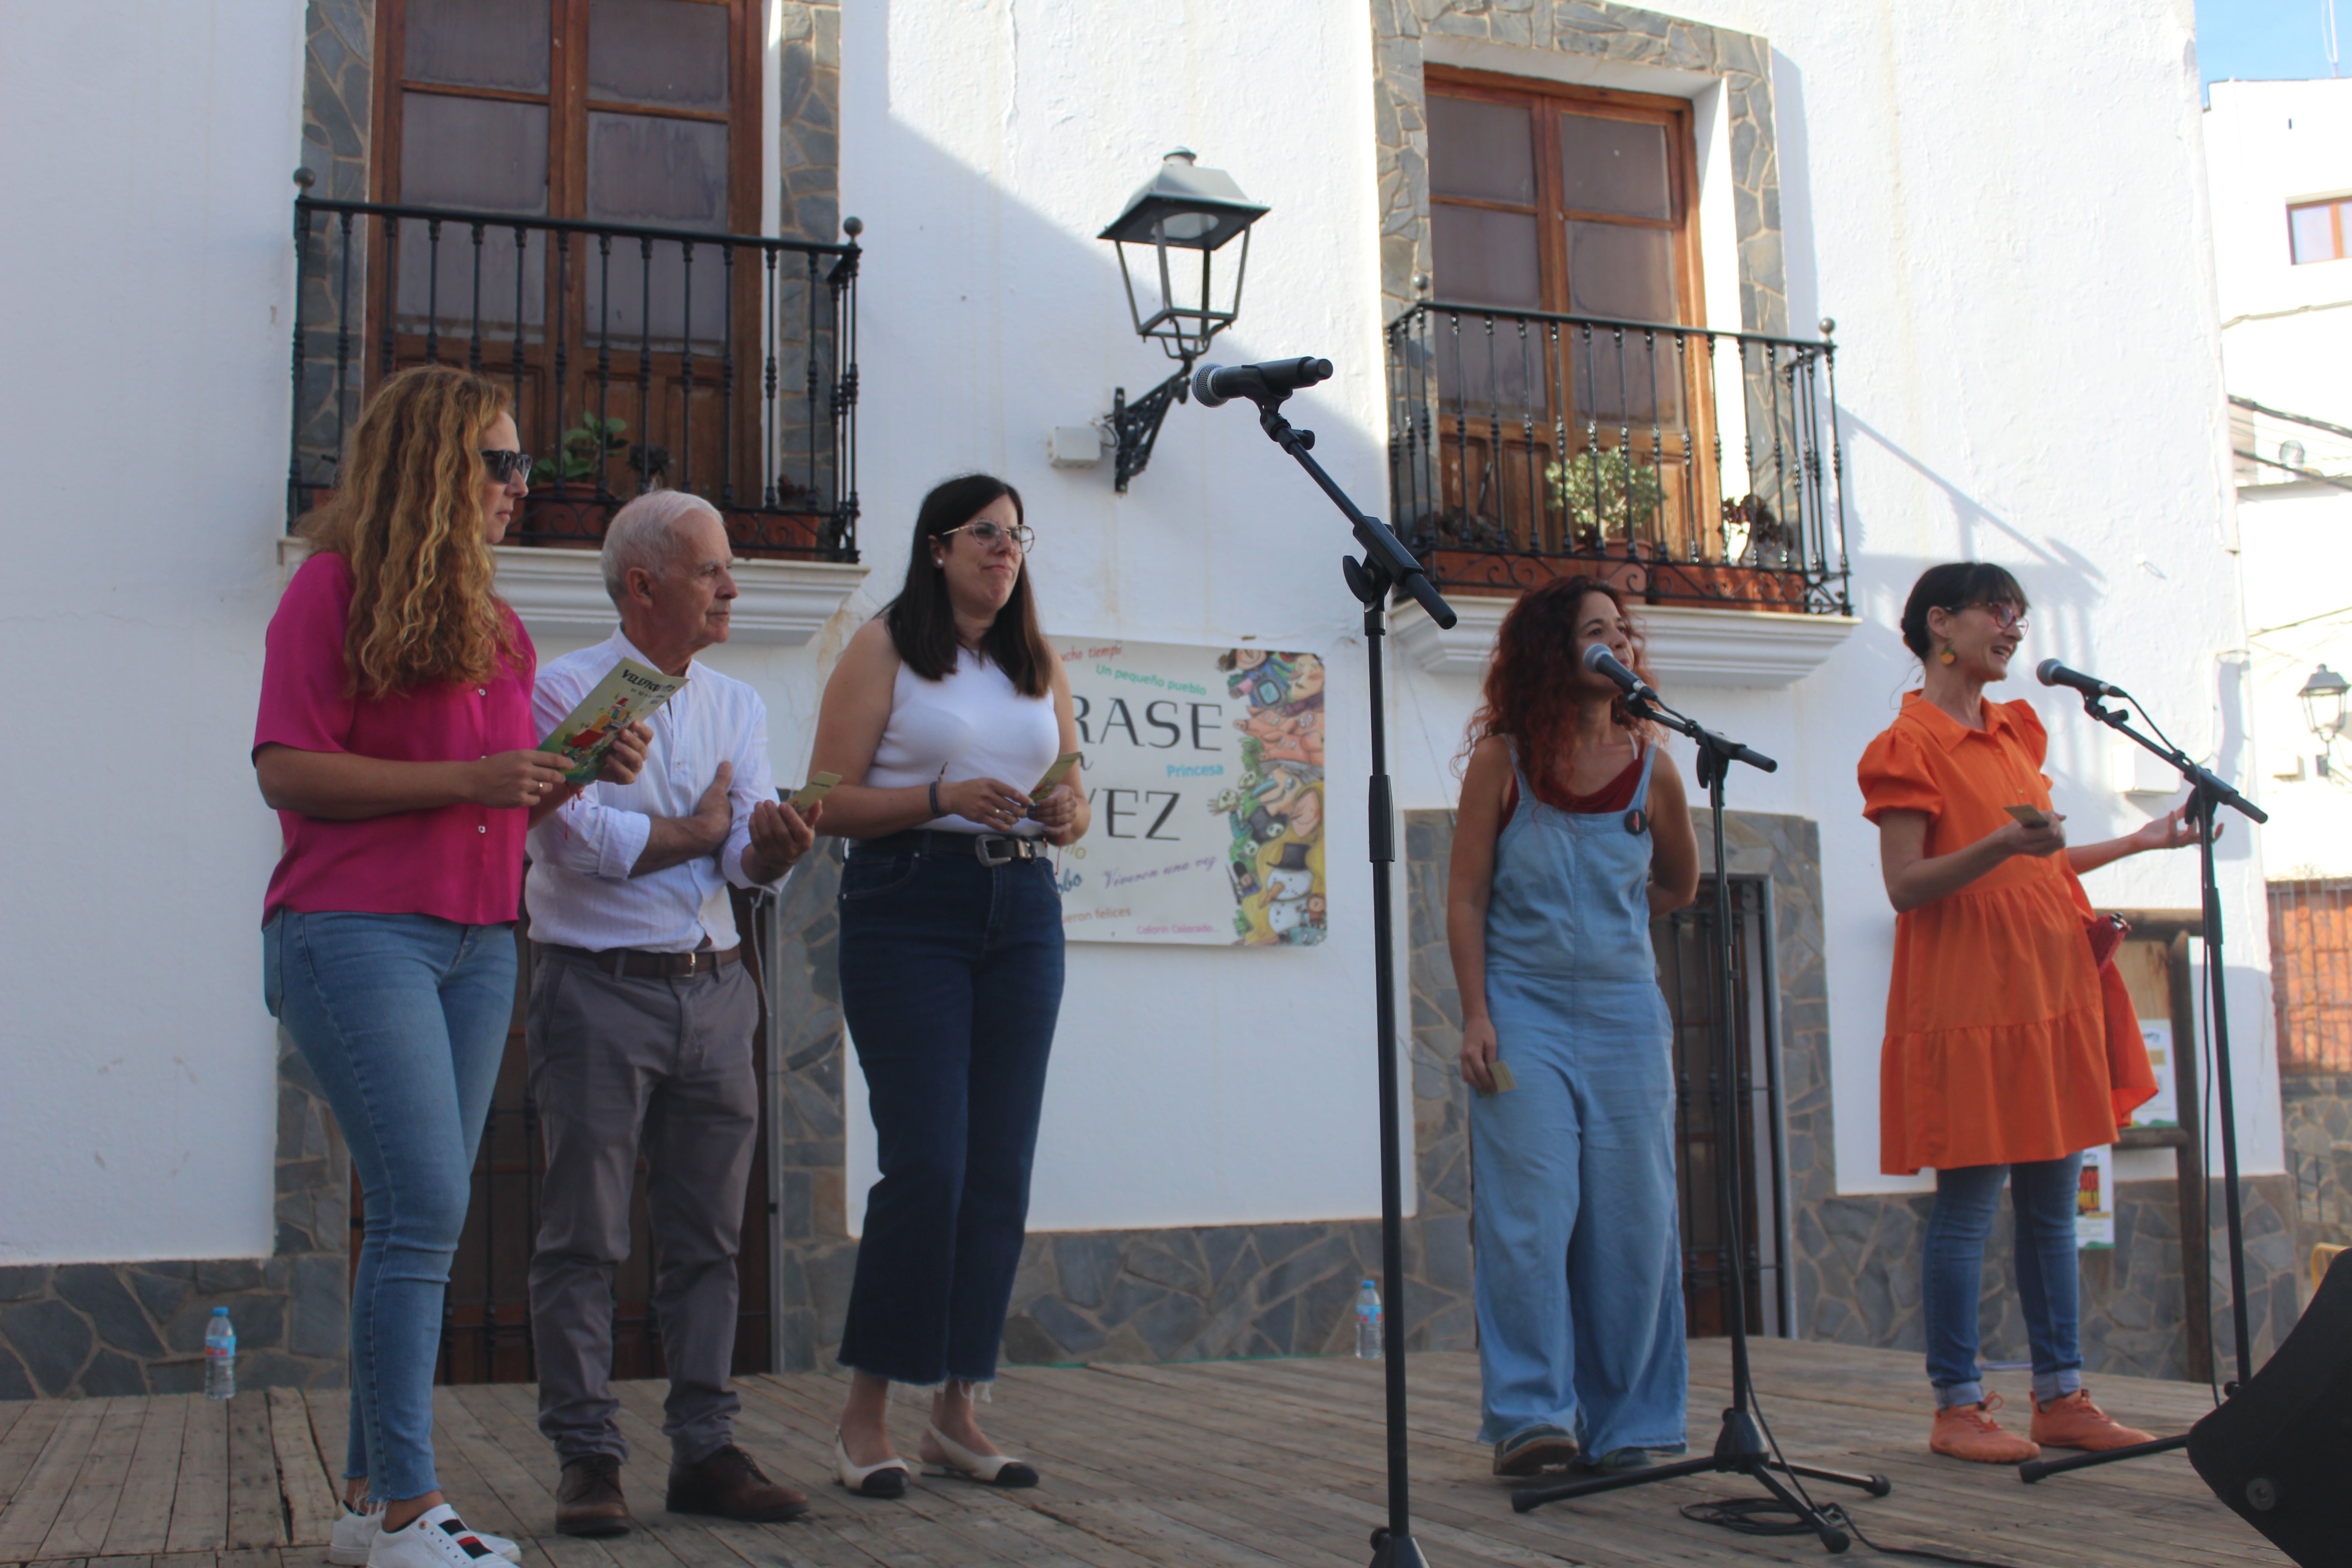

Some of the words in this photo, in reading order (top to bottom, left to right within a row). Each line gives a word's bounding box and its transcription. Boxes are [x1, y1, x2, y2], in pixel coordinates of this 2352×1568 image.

[1096, 664, 1112, 676] Un
[1114, 669, 1165, 687] pequeño
[1167, 681, 1207, 696] pueblo
[1072, 695, 1222, 751] RASE
[1166, 764, 1224, 778] Princesa
[1089, 788, 1181, 840] EZ
[1057, 867, 1083, 894] obo
[1095, 906, 1132, 919] felices
